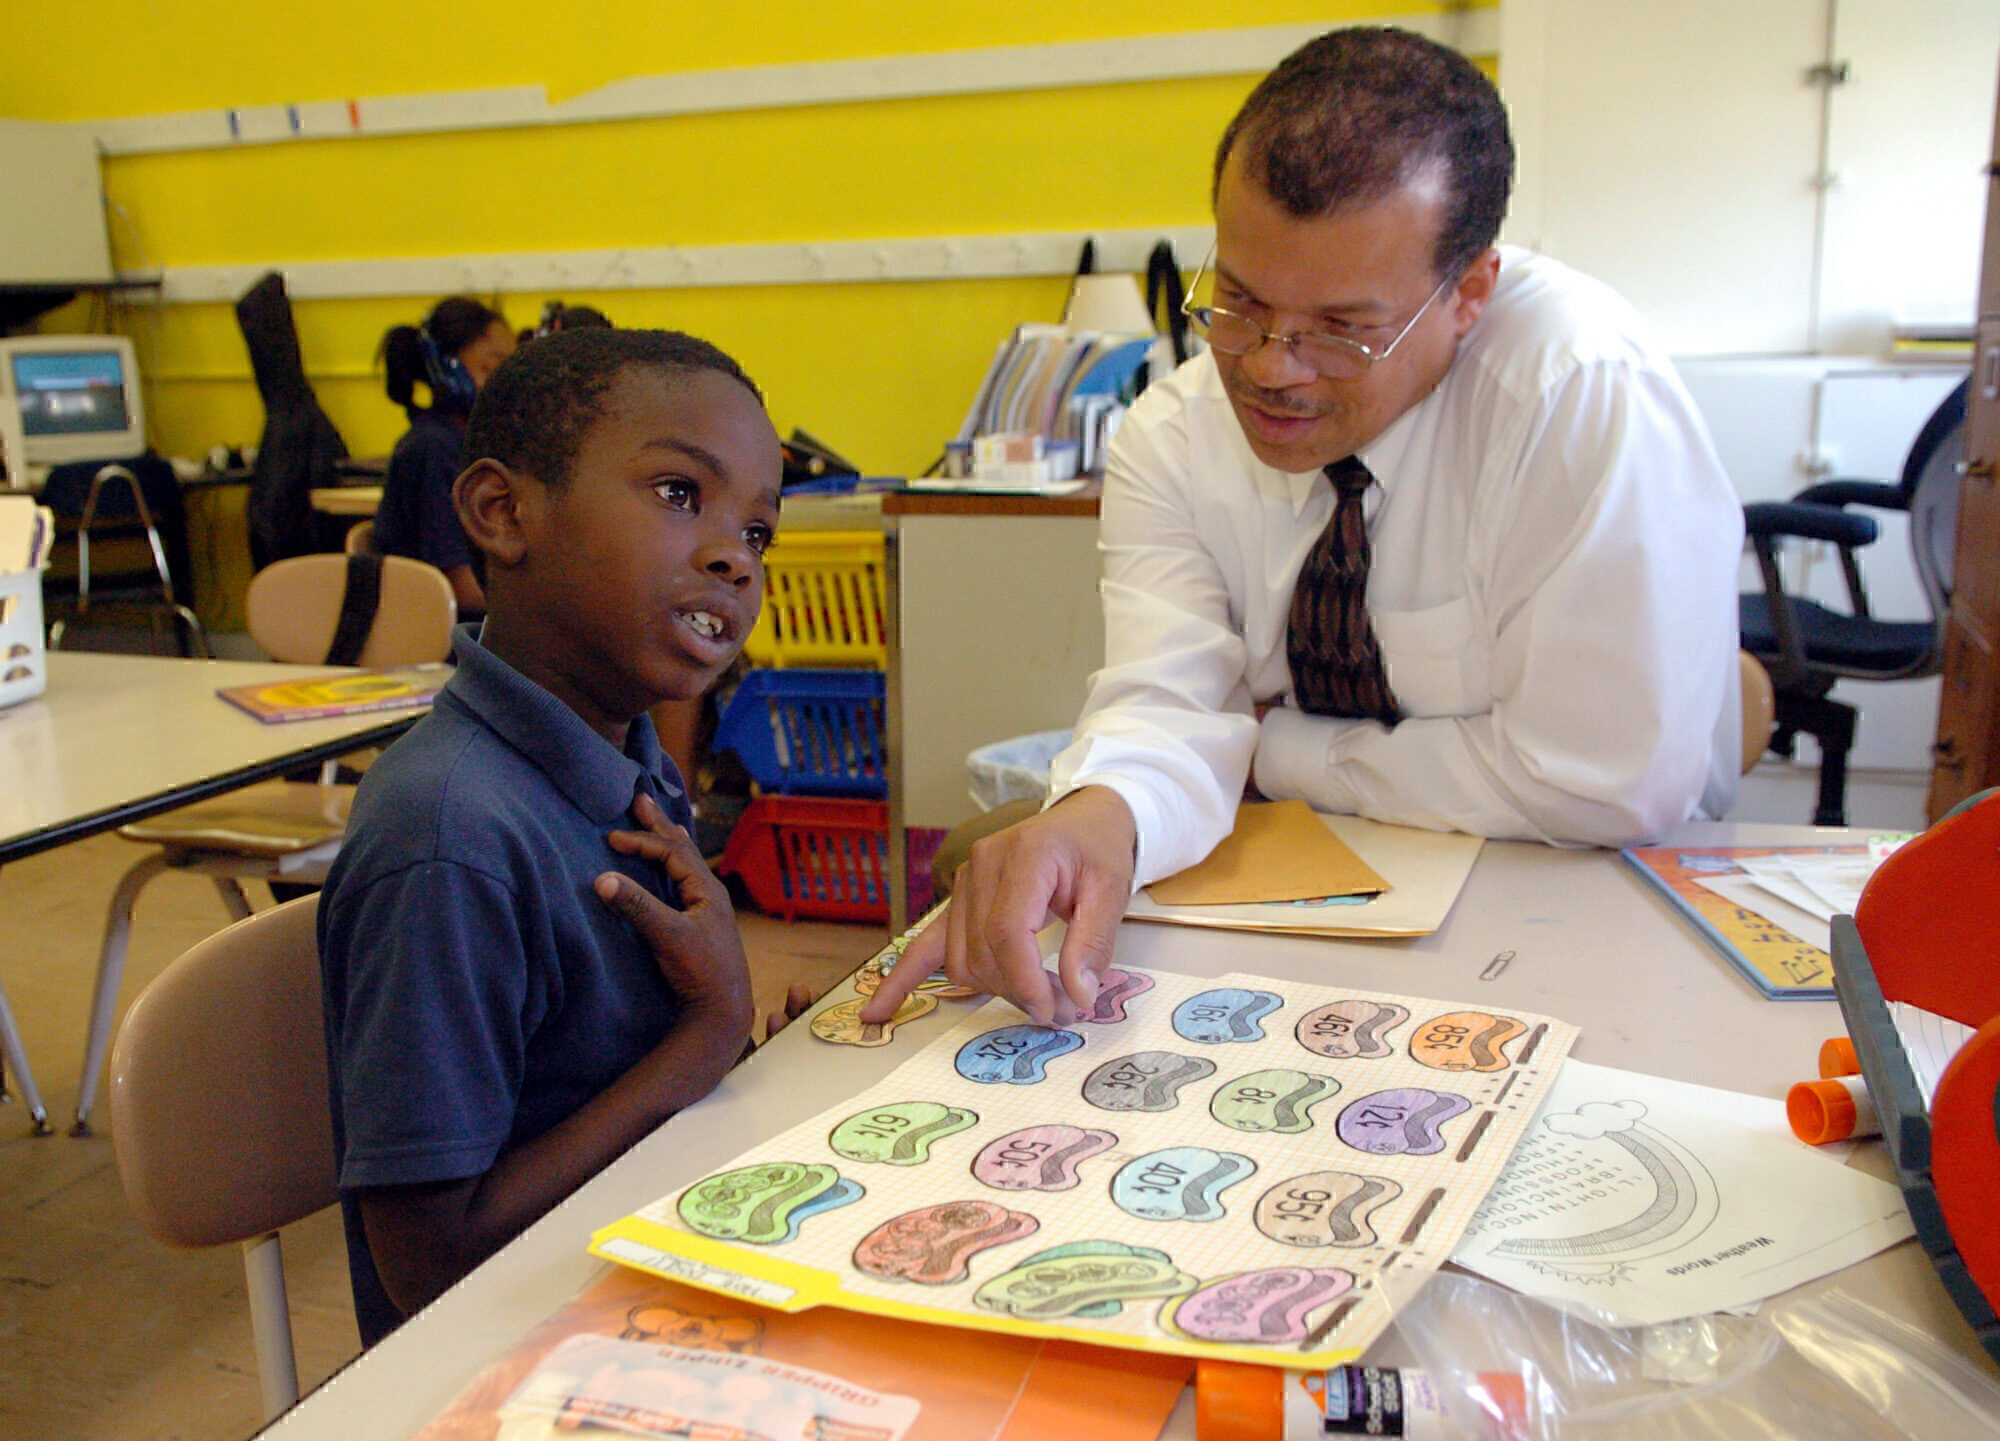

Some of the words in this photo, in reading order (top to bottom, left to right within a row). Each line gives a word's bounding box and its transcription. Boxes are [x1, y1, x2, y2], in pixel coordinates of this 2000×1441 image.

[1191, 1003, 1230, 1024] 16¢
[1308, 1015, 1356, 1038] 46¢
[975, 1035, 1028, 1062] 32¢
[1424, 1023, 1470, 1051] 85¢
[1103, 1061, 1159, 1090] 26¢
[1231, 1087, 1277, 1105] 8¢
[854, 1113, 911, 1139] 61¢
[1355, 1103, 1408, 1129] 12¢
[992, 1138, 1053, 1168] 50¢
[1130, 1161, 1188, 1195] 40¢
[1273, 1188, 1332, 1222] 95¢
[1715, 1236, 1775, 1262] Weather
[1666, 1254, 1717, 1276] Words
